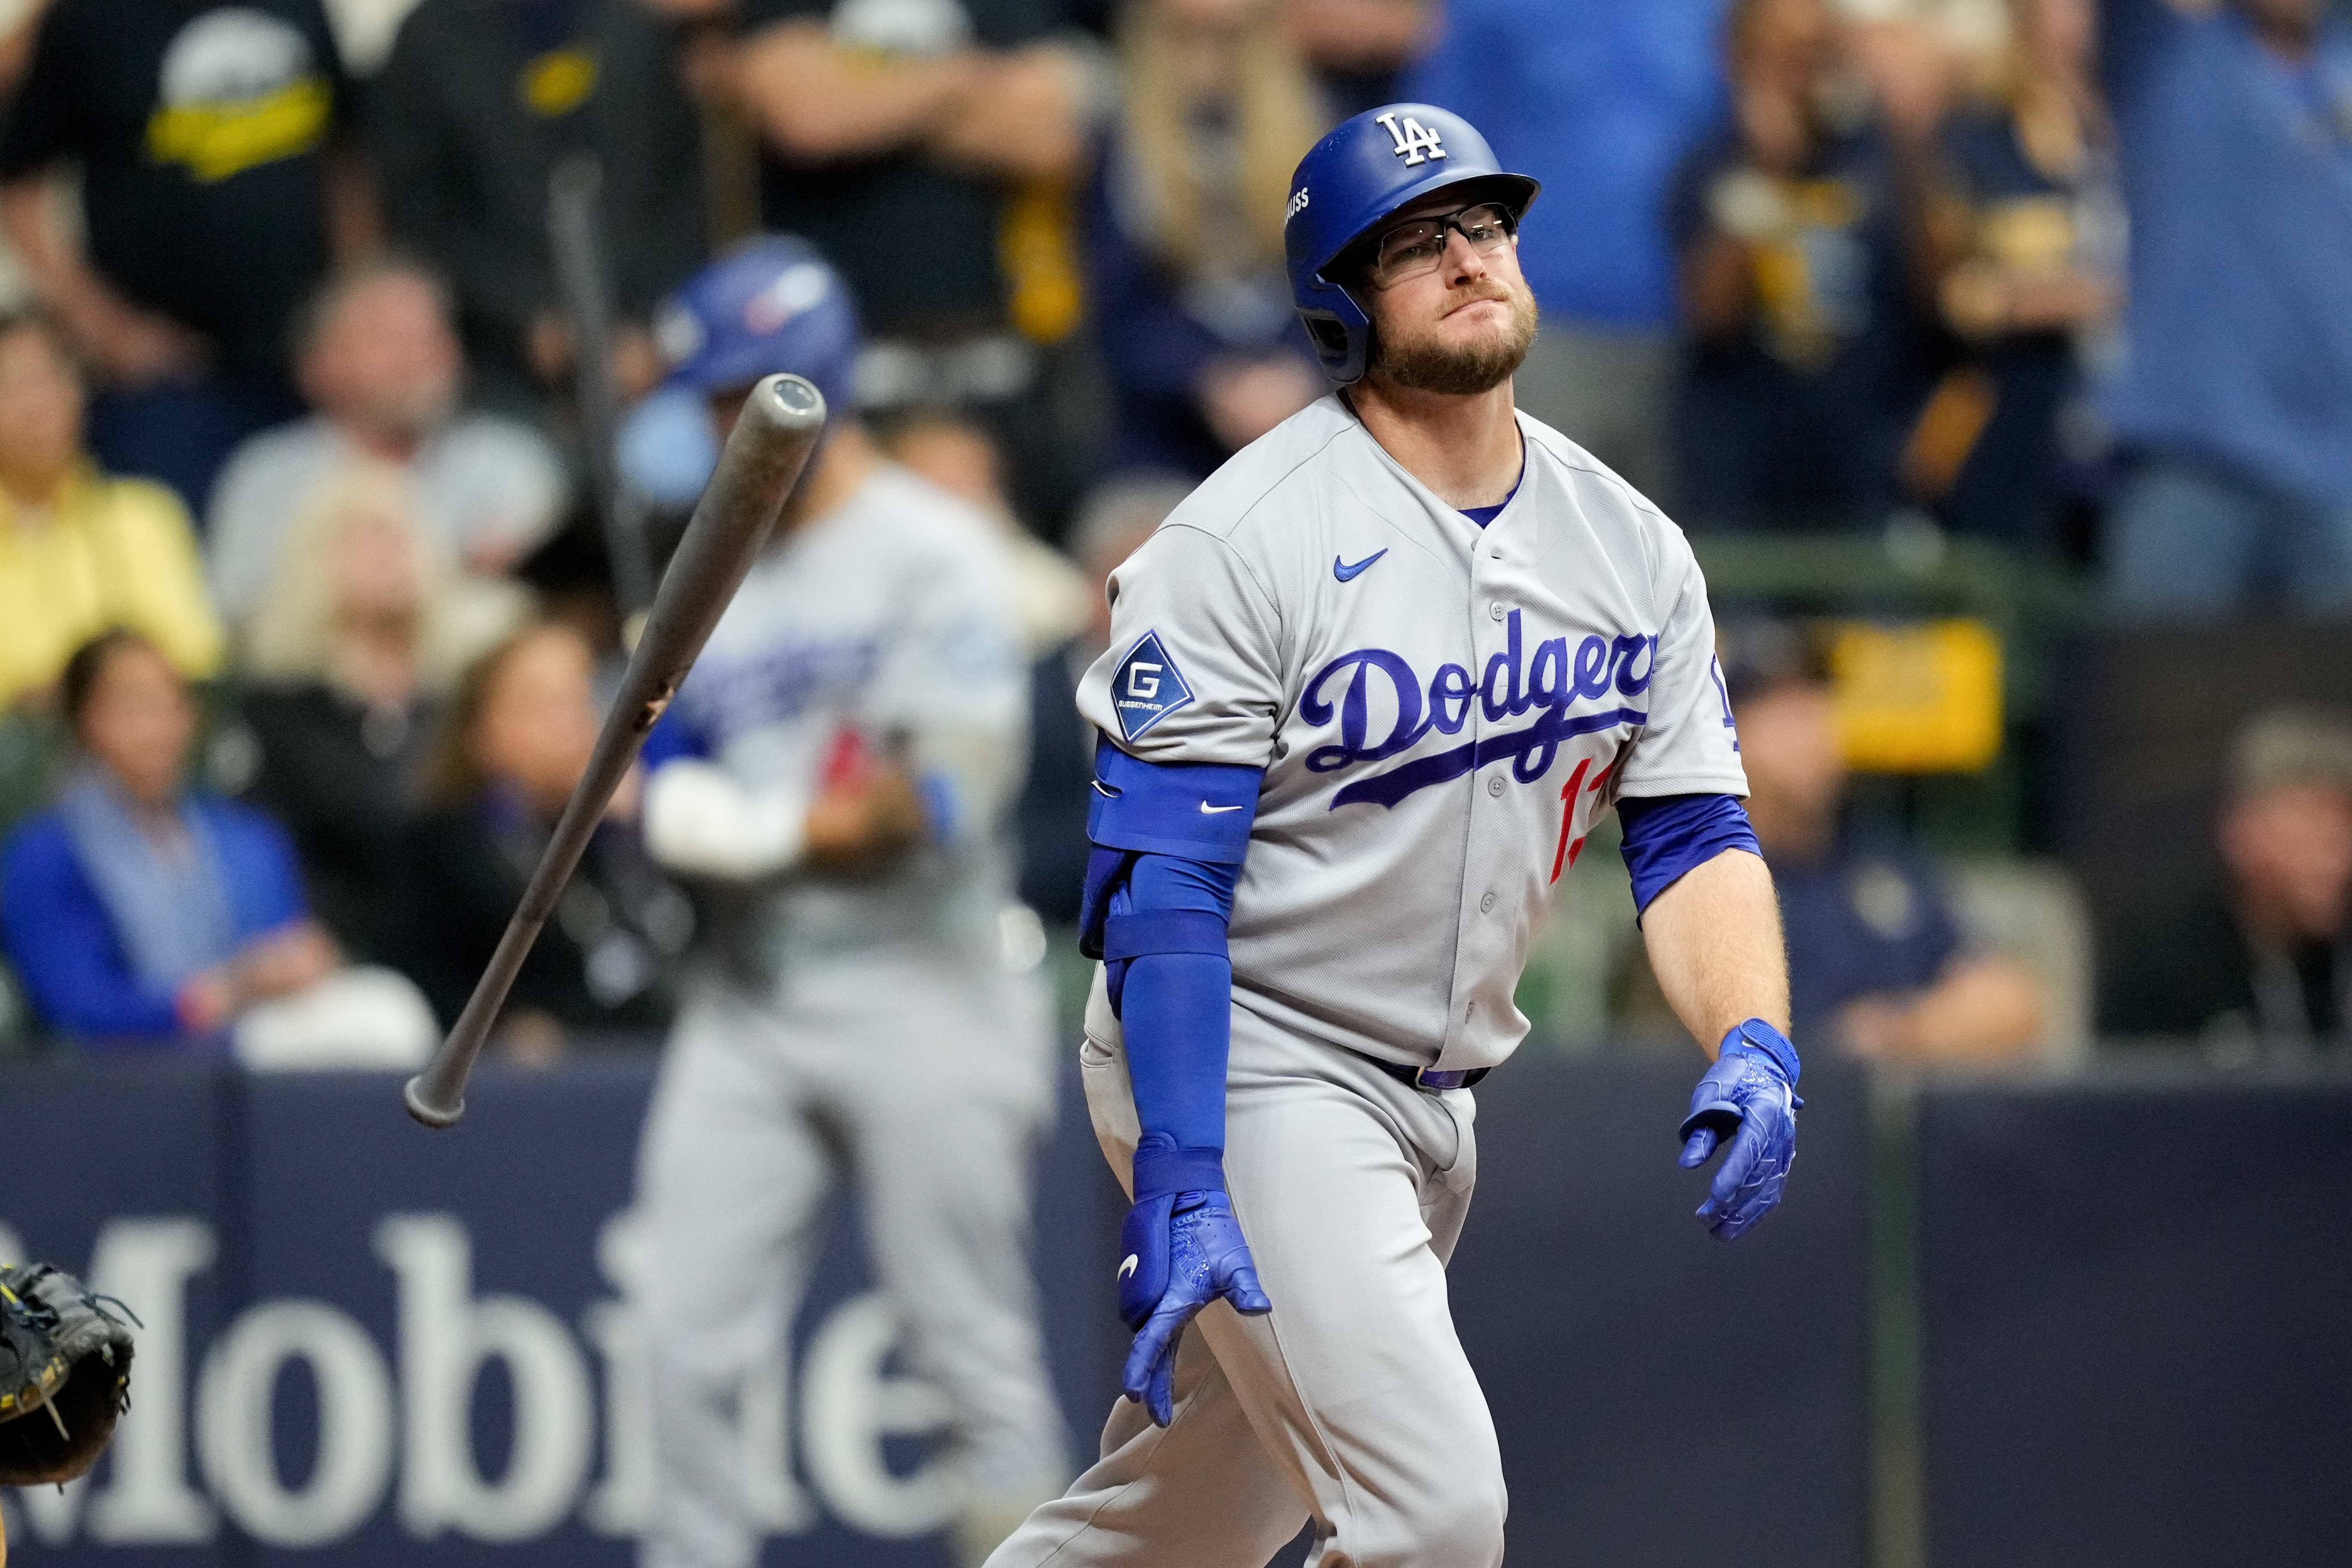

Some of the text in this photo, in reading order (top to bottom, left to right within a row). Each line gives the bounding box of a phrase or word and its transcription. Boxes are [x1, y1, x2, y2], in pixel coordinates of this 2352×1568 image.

[1376, 112, 1447, 166] LA
[1285, 187, 1309, 225] AUSS
[1128, 662, 1163, 698] G
[1299, 608, 1658, 784] Dodger
[1119, 700, 1163, 712] GUGGENHEIM
[1549, 757, 1617, 885] 1
